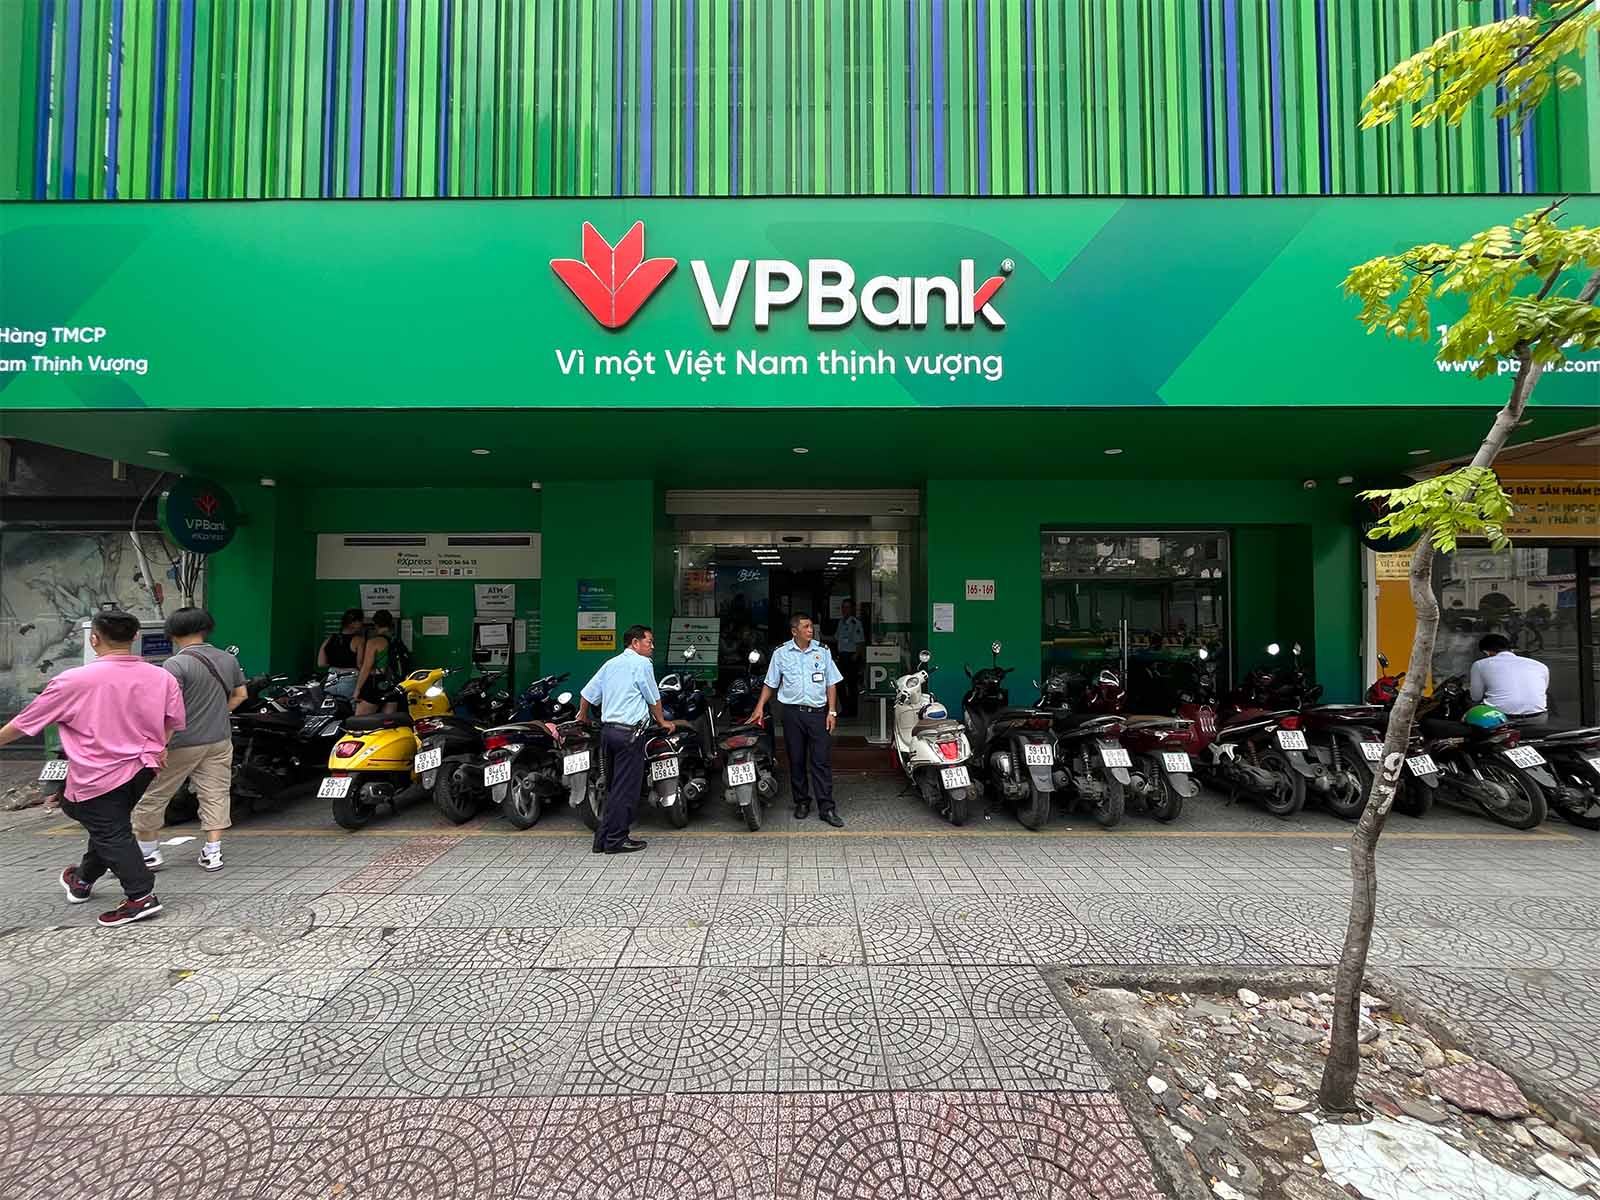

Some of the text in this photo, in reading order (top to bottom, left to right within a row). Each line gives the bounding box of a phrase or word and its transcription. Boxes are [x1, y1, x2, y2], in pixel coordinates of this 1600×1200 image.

[690, 259, 1006, 328] VPBank
[0, 327, 106, 347] Hàng TMCP
[32, 355, 83, 375] Thịnh
[88, 355, 148, 375] Vượng
[555, 349, 1003, 382] Vì một Việt Nam thịnh vượng
[870, 666, 887, 690] P
